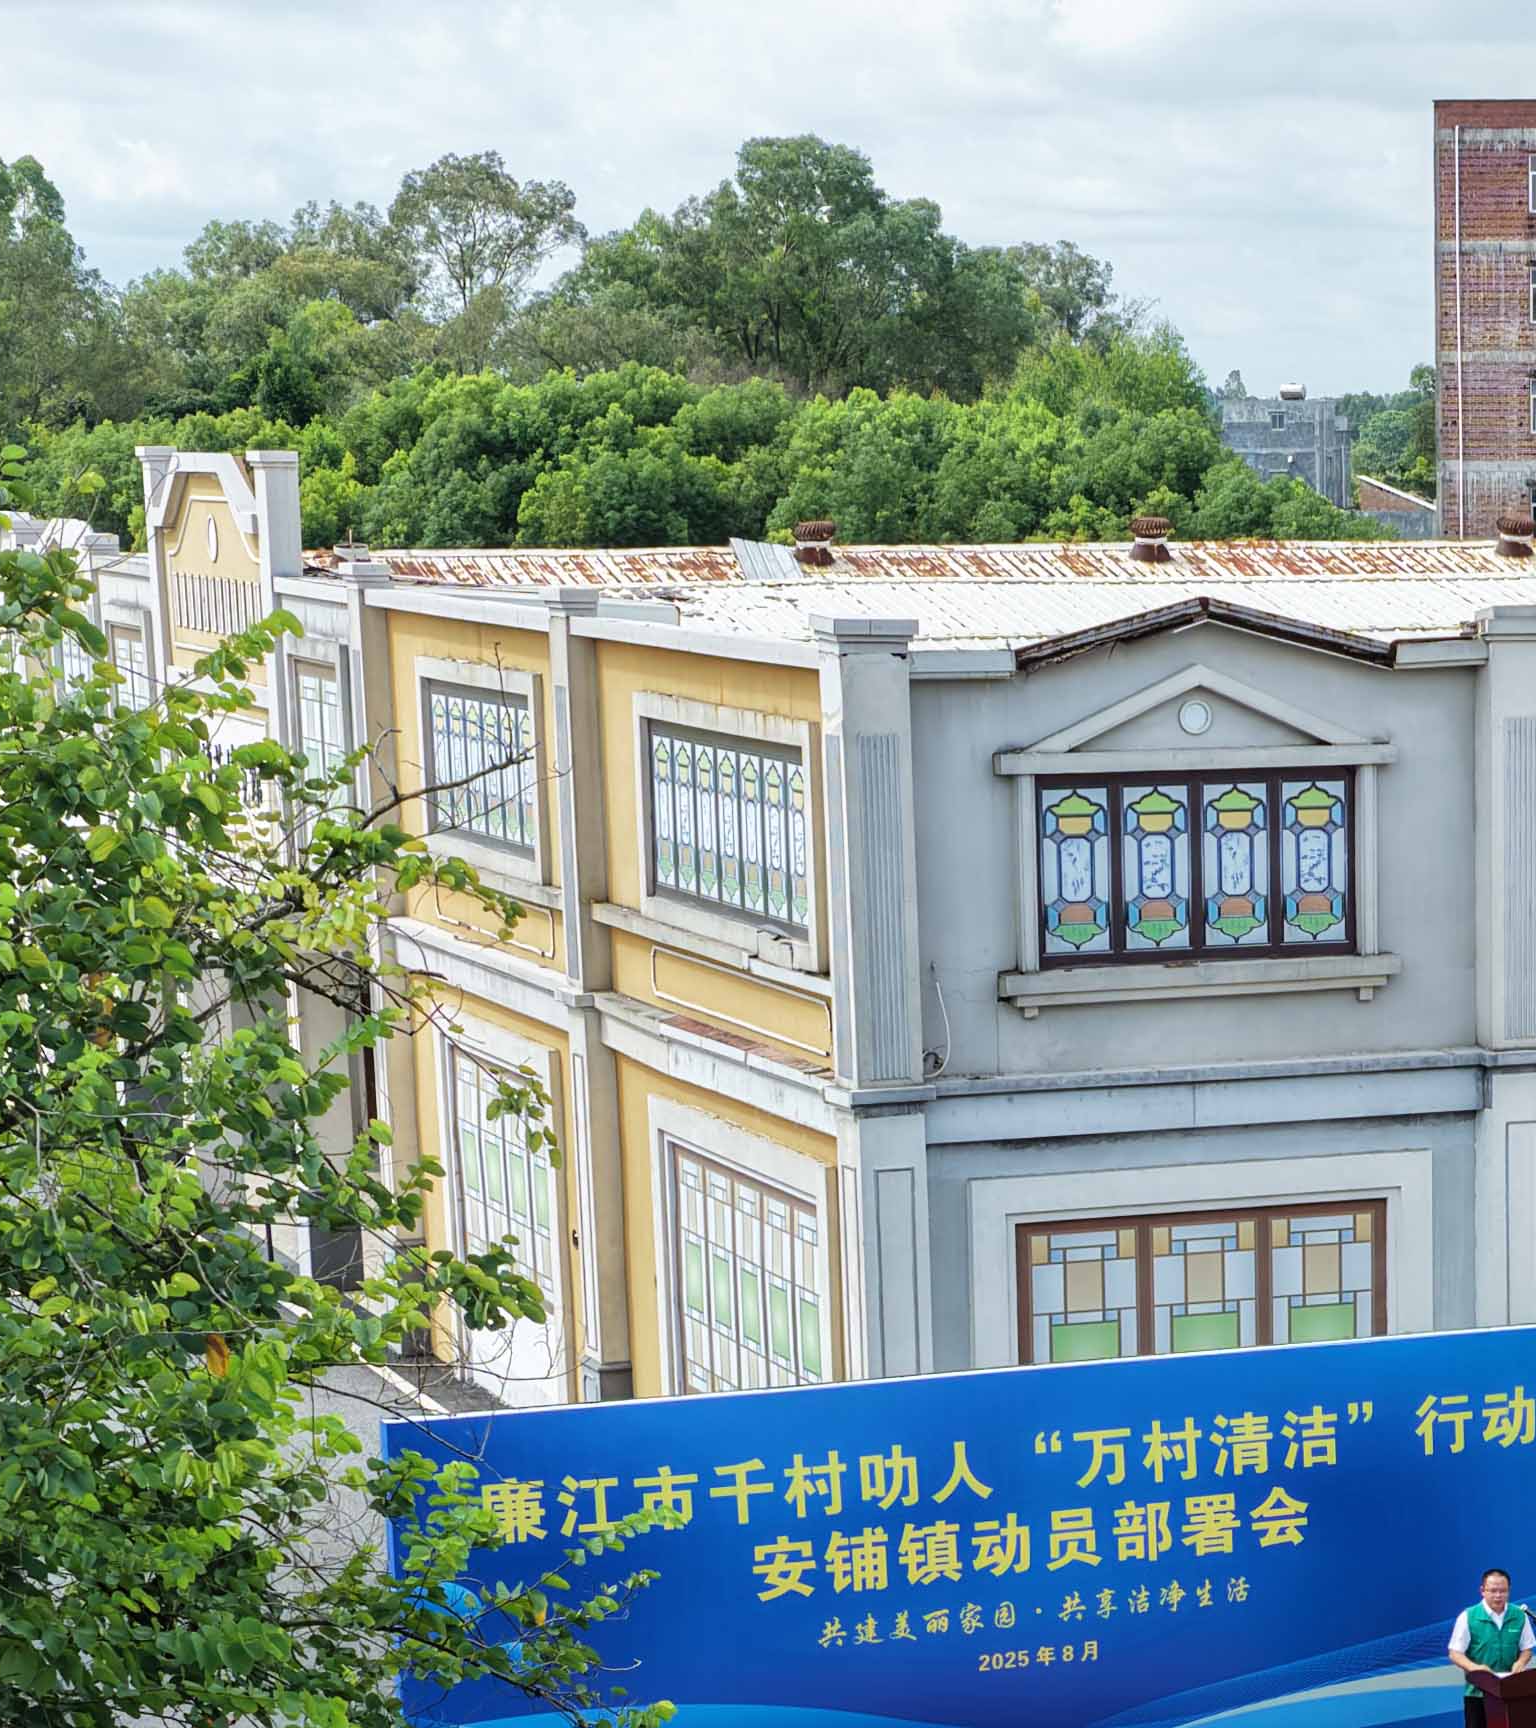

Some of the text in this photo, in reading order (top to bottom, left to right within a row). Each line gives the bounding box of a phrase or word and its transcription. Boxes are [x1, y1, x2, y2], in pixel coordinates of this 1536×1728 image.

[753, 1487, 1307, 1601] 安铺镇动员部署会
